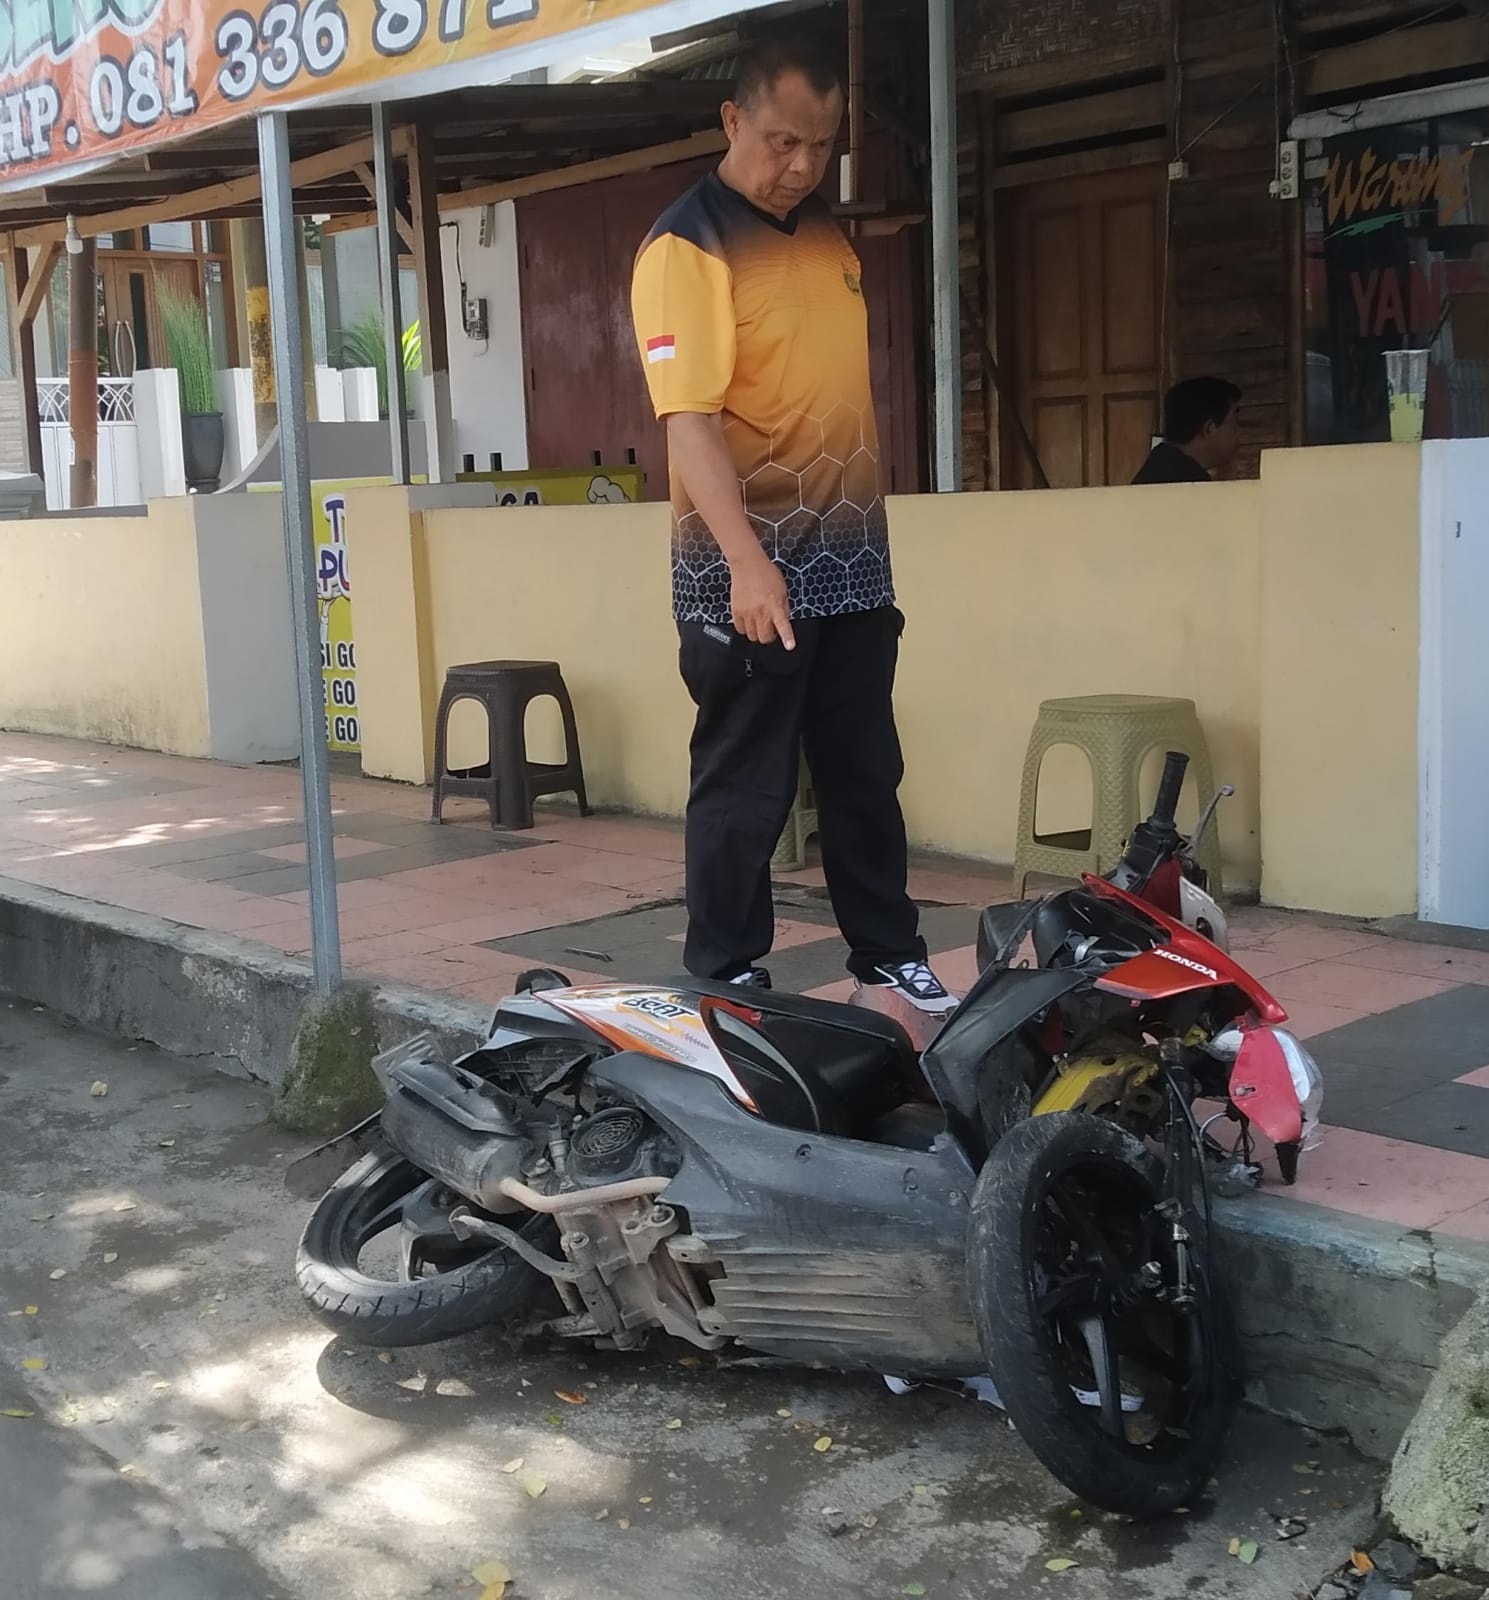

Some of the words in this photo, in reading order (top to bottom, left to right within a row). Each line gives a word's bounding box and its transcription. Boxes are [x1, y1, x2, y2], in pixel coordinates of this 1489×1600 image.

[215, 0, 349, 102] 336
[335, 716, 361, 742] GO
[1153, 948, 1219, 980] HONDA
